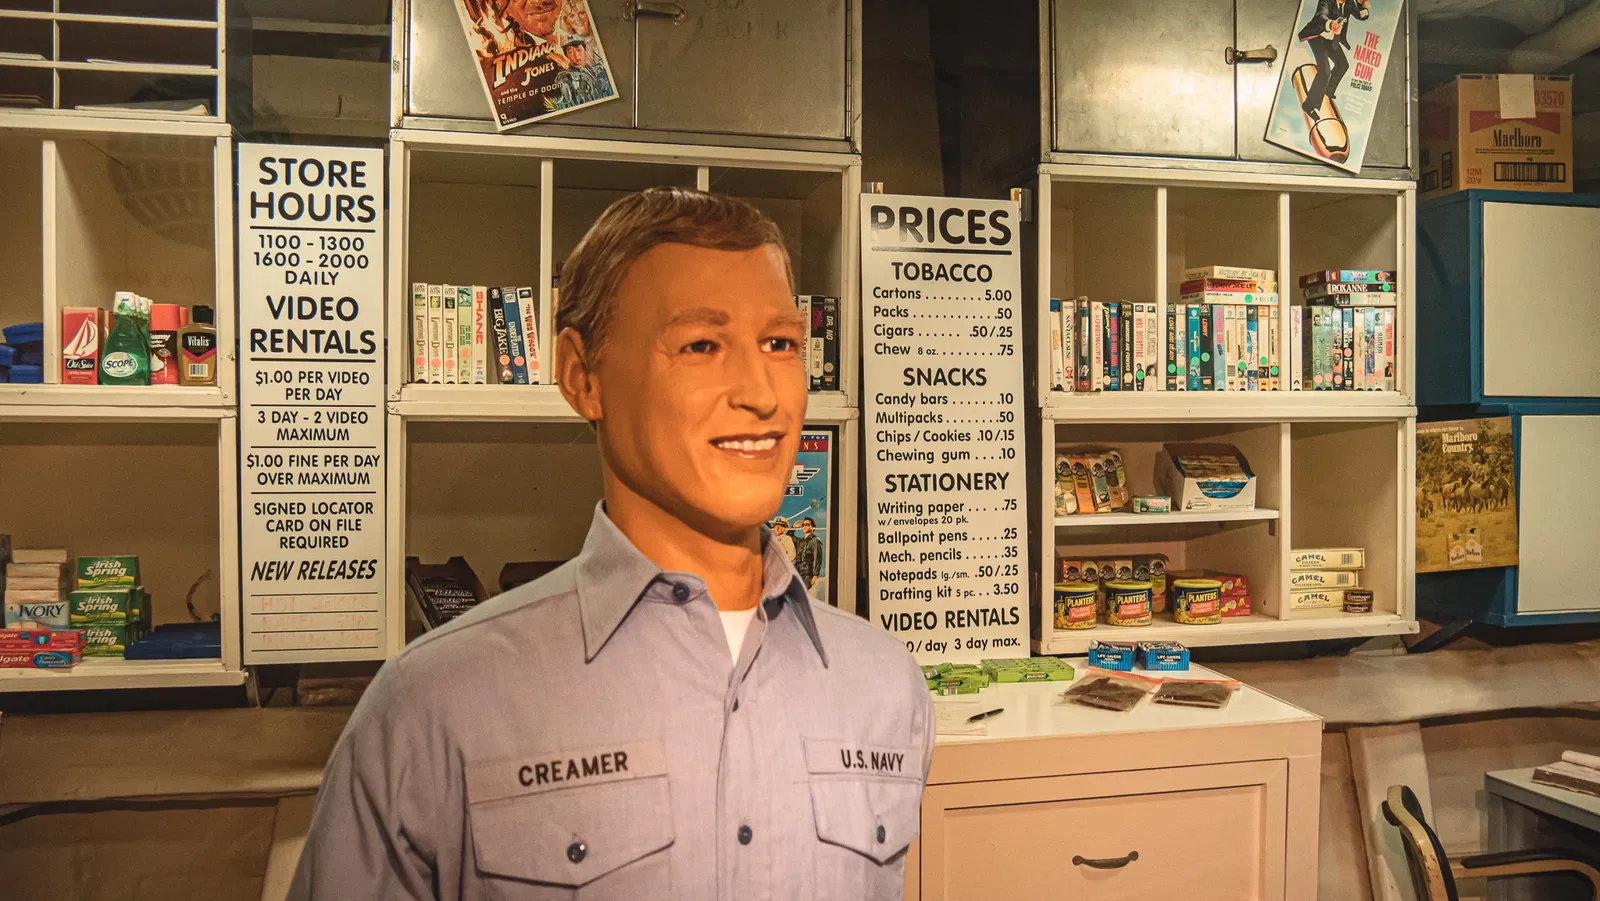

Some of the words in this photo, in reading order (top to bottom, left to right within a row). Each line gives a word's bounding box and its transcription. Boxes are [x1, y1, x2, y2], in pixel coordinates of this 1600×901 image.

[1364, 32, 1380, 50] THE
[1354, 45, 1382, 68] NAKED
[494, 41, 556, 89] INDIANA
[1354, 62, 1374, 82] GUN
[521, 61, 554, 86] JONES
[498, 92, 527, 105] TEMPLE
[529, 89, 539, 97] OF
[541, 82, 564, 93] DOOM
[1493, 127, 1542, 148] Marlboro
[259, 156, 367, 188] STORE
[250, 191, 376, 223] HOURS
[870, 205, 1012, 246] PRICES
[258, 234, 301, 250] 1100
[319, 236, 364, 252] 1300
[254, 252, 300, 267] 1600
[319, 254, 369, 269] 2000
[285, 270, 339, 286] DAILY
[891, 262, 992, 283] TOBACCO
[872, 286, 922, 300] Cartons
[985, 290, 1012, 301] 5.00
[1332, 284, 1368, 292] ROXANNE
[266, 295, 359, 322] VIDEO
[873, 306, 909, 318] Packs
[476, 290, 484, 344] SHANE
[494, 308, 504, 327] BIG
[826, 330, 834, 340] NO
[874, 324, 914, 340] Cigars
[188, 336, 210, 346] Vitalis
[250, 328, 376, 355] RENTALS
[494, 325, 508, 355] JAKE
[874, 343, 911, 355] Chew
[918, 347, 924, 355] 8
[66, 360, 80, 370] Old
[80, 360, 94, 370] Spice
[104, 360, 134, 369] SCOPE
[256, 370, 293, 386] $1.00
[298, 371, 324, 384] PER
[328, 372, 370, 385] VIDEO
[903, 367, 987, 386] SNACKS
[286, 388, 310, 400] PER
[316, 388, 343, 400] DAY
[876, 393, 916, 408] Candy
[920, 392, 948, 405] bars
[258, 411, 266, 424] 3
[272, 411, 298, 424] DAY
[314, 411, 322, 424] 2
[326, 412, 368, 424] VIDEO
[876, 412, 943, 426] Multipacks
[276, 428, 350, 441] MAXIMUM
[1442, 432, 1478, 444] Marlboro
[1442, 442, 1474, 454] Country.
[246, 452, 284, 470] $1.00
[288, 455, 318, 468] FINE
[324, 454, 349, 468] PER
[354, 454, 380, 468] DAY
[876, 449, 935, 464] Chewing
[942, 450, 971, 464] gum
[257, 472, 294, 486] OVER
[298, 472, 370, 485] MAXIMUM
[884, 472, 1010, 493] STATIONERY
[254, 502, 306, 516] SIGNED
[312, 502, 374, 515] LOCATOR
[878, 502, 924, 516] Writing
[928, 502, 964, 516] paper
[266, 519, 304, 532] CARD
[310, 518, 331, 532] ON
[336, 518, 362, 532] FILE
[941, 516, 953, 524] 20
[956, 516, 969, 526] pk.
[280, 536, 350, 550] REQUIRED
[878, 530, 935, 546] Ballpoint
[938, 530, 968, 544] pens
[878, 550, 915, 564] Mech.
[920, 548, 962, 564] pencils
[1296, 554, 1326, 562] CAMEL
[85, 566, 127, 577] Spring
[96, 560, 122, 568] Irish
[250, 560, 294, 582] NEW
[297, 559, 378, 580] RELEASES
[880, 568, 938, 584] Notepads
[1292, 574, 1325, 584] CAMEL
[880, 587, 932, 602] Drafting
[937, 586, 952, 598] kit
[956, 590, 961, 598] 5
[964, 590, 976, 598] pc.
[993, 582, 1020, 596] 3.50
[1118, 593, 1146, 605] PLANTERS
[1188, 591, 1217, 603] PLANTERS
[1298, 594, 1330, 604] CAMEL
[77, 602, 118, 612] Spring
[88, 596, 112, 604] Irish
[1067, 596, 1095, 607] PLANTERS
[18, 603, 66, 618] IVORY
[880, 610, 938, 632] VIDEO
[945, 606, 1020, 629] RENTALS
[88, 636, 117, 646] ring
[954, 638, 962, 650] 3
[966, 637, 988, 651] day
[992, 636, 1021, 648] max.
[0, 656, 30, 664] lgate
[840, 748, 868, 770] U.S.
[871, 751, 905, 773] NAVY
[518, 750, 628, 787] CREAMER
